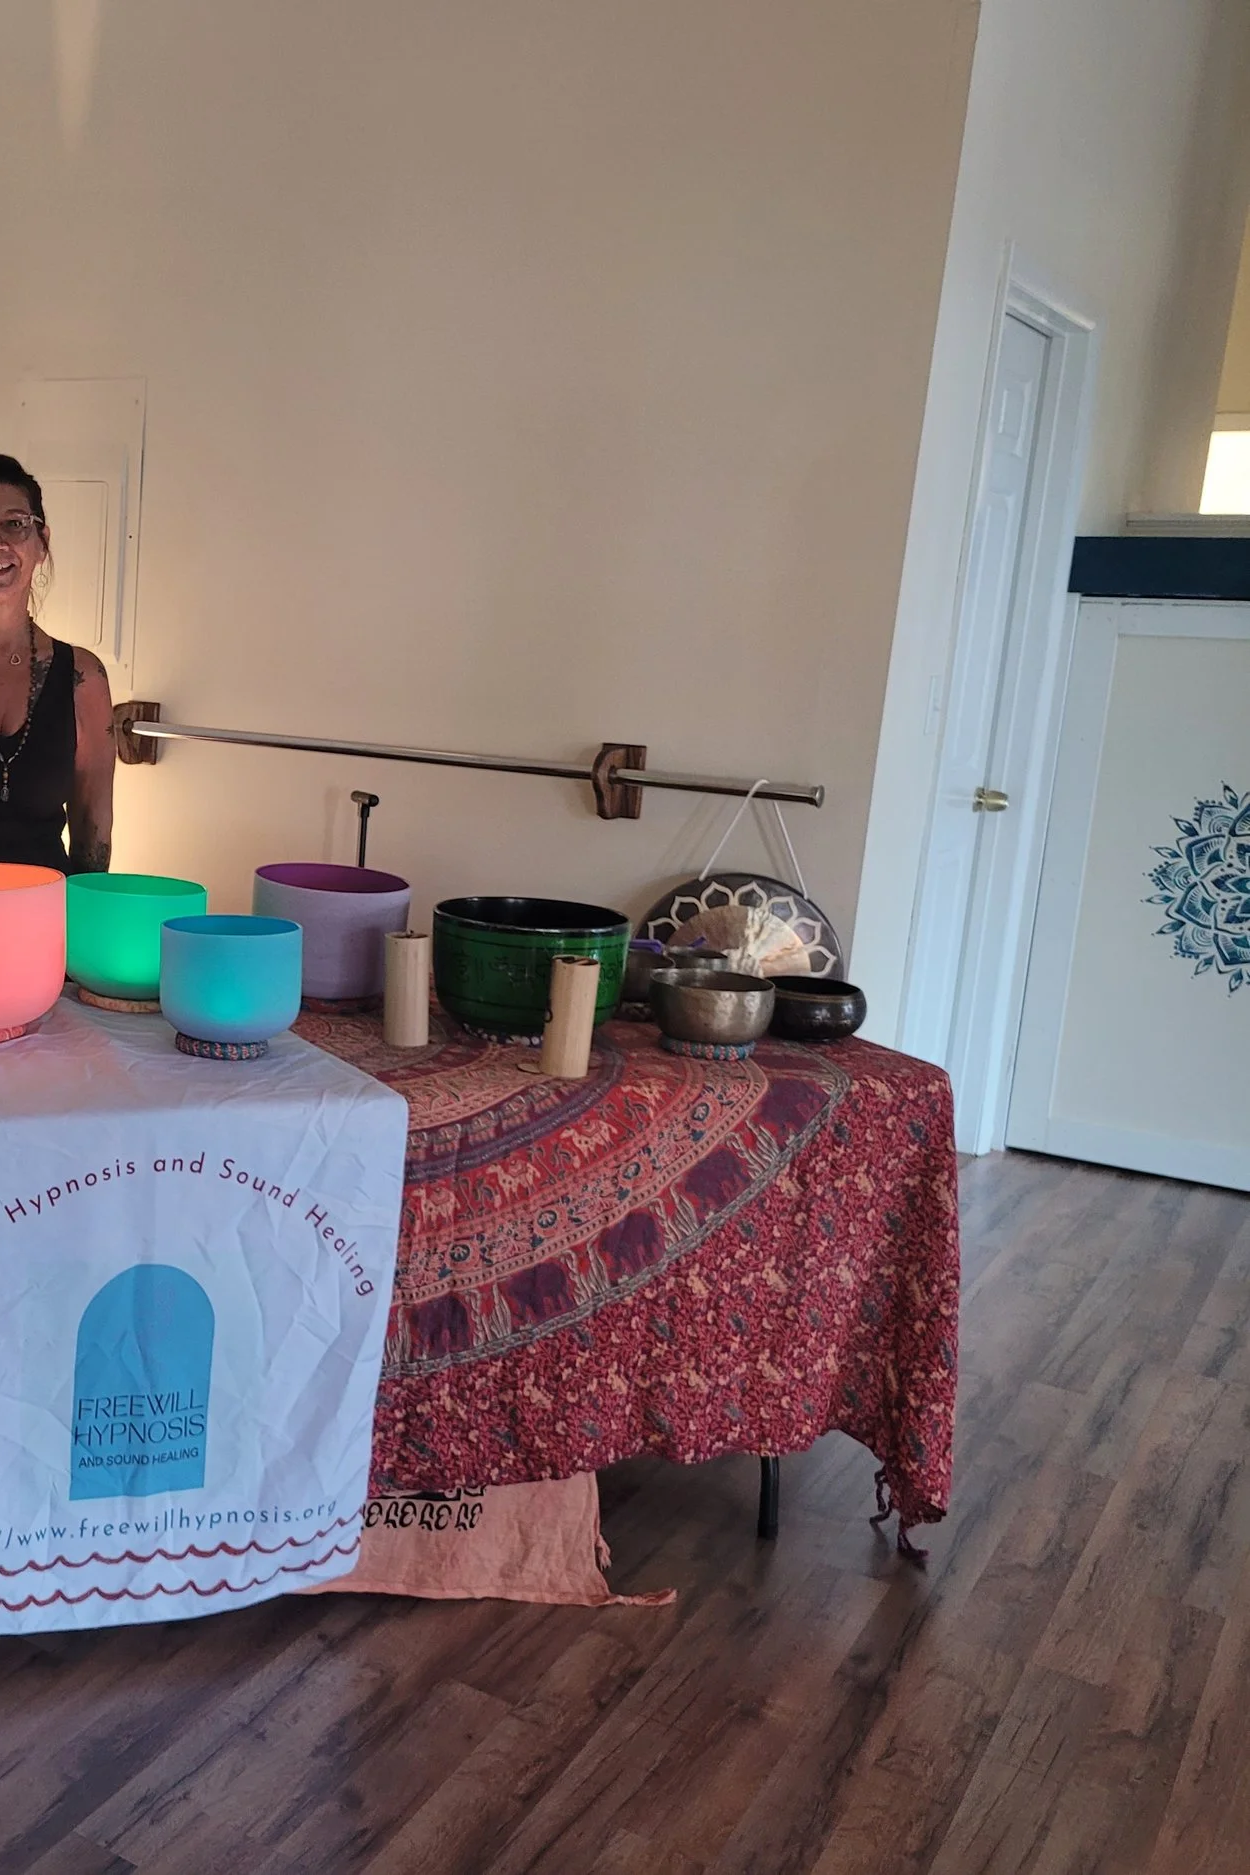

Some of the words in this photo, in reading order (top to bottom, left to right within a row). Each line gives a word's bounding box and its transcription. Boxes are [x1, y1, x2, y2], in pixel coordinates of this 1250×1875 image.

[3, 1158, 137, 1224] Hypnosis
[152, 1151, 206, 1174] and
[218, 1158, 301, 1208] Sound
[304, 1203, 375, 1297] Healing
[77, 1387, 204, 1421] FREEWILL
[74, 1412, 206, 1447] HYPNOSIS
[78, 1455, 104, 1469] AND
[105, 1453, 150, 1467] SOUND
[151, 1446, 199, 1465] HEALING
